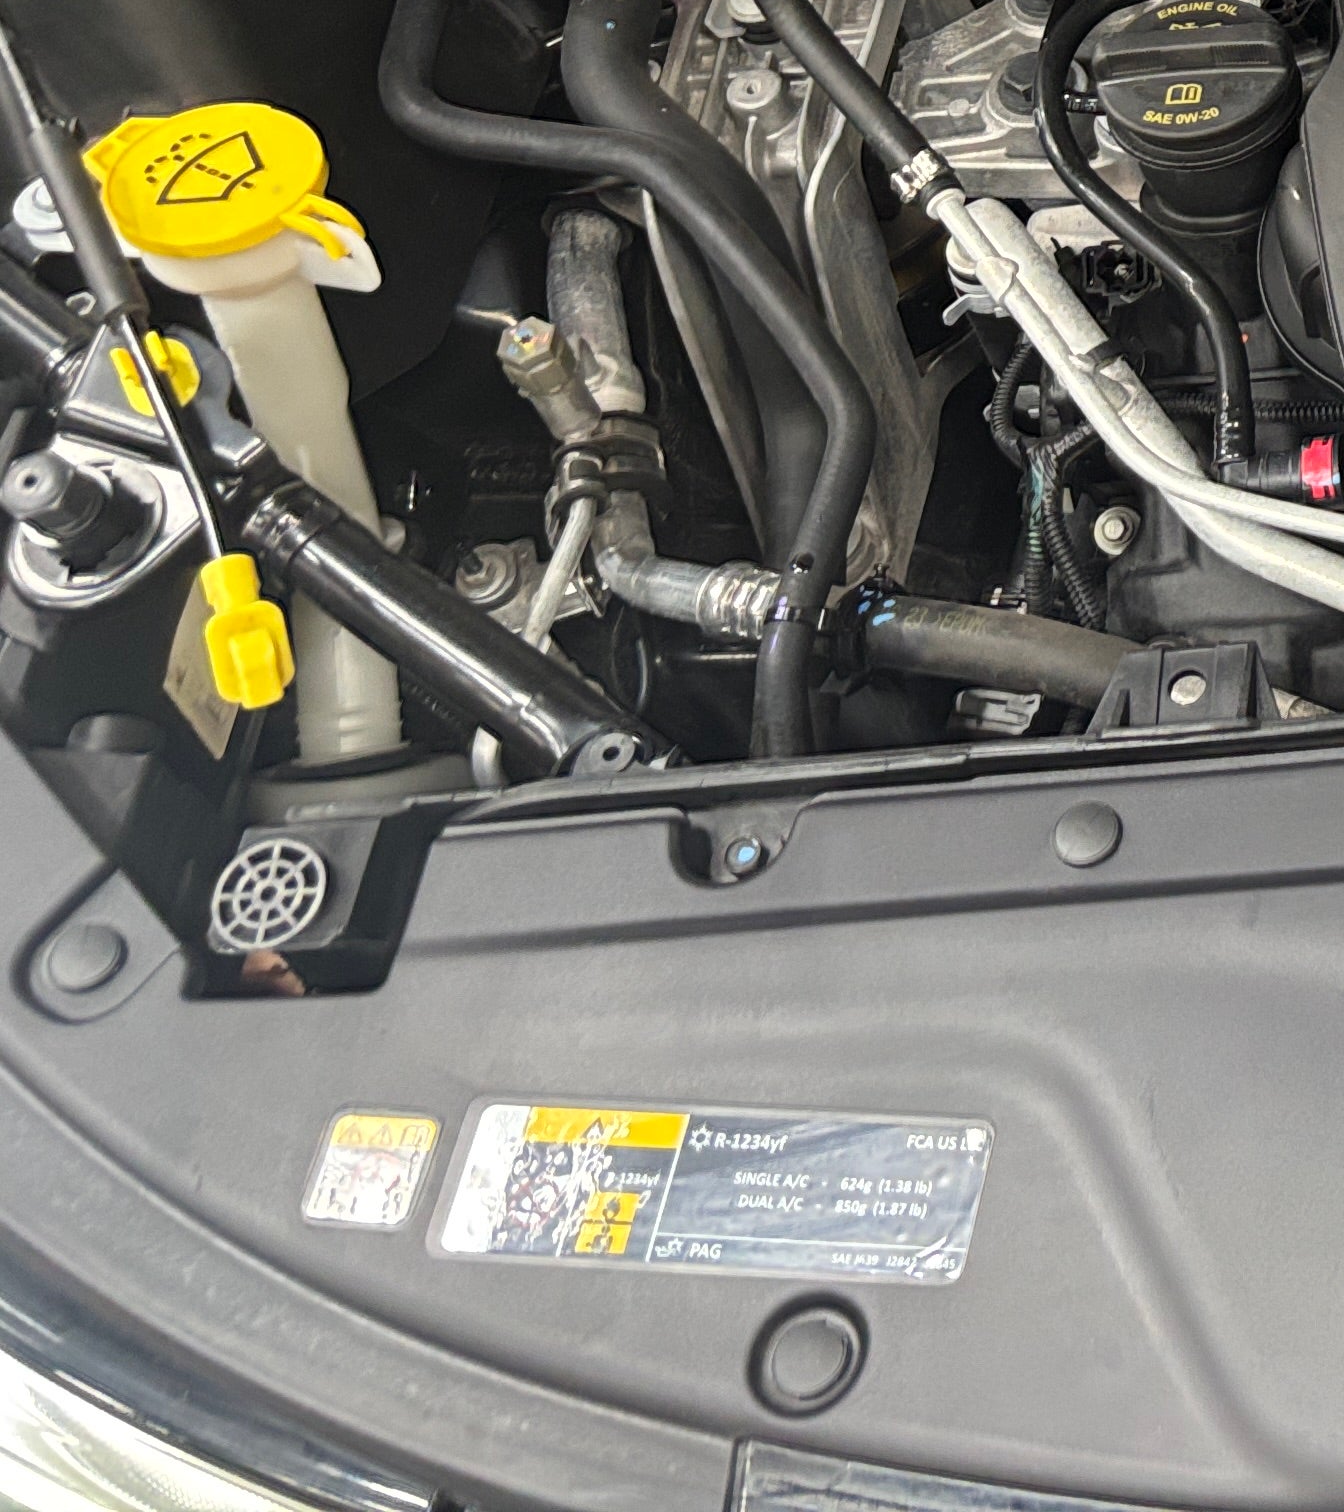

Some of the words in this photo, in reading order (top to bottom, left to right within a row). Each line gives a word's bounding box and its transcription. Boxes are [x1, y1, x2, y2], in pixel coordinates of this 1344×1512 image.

[1157, 0, 1214, 21] ENGINE
[1216, 2, 1239, 17] OIL
[1142, 109, 1173, 125] SAE
[1175, 107, 1220, 125] 0W-20
[714, 1131, 788, 1154] R-1234yf
[906, 1134, 934, 1150] FCA
[937, 1135, 958, 1150] US
[733, 1171, 780, 1187] SINGLE
[783, 1173, 809, 1190] A/C
[840, 1177, 872, 1194] 624g
[878, 1178, 912, 1195] (1.38
[914, 1180, 933, 1197] lb)
[738, 1194, 775, 1209] DUAL
[777, 1196, 804, 1213] A/C
[834, 1199, 867, 1216] 850g
[872, 1200, 906, 1217] (1.87
[908, 1202, 928, 1220] lb)
[689, 1243, 722, 1260] PAG
